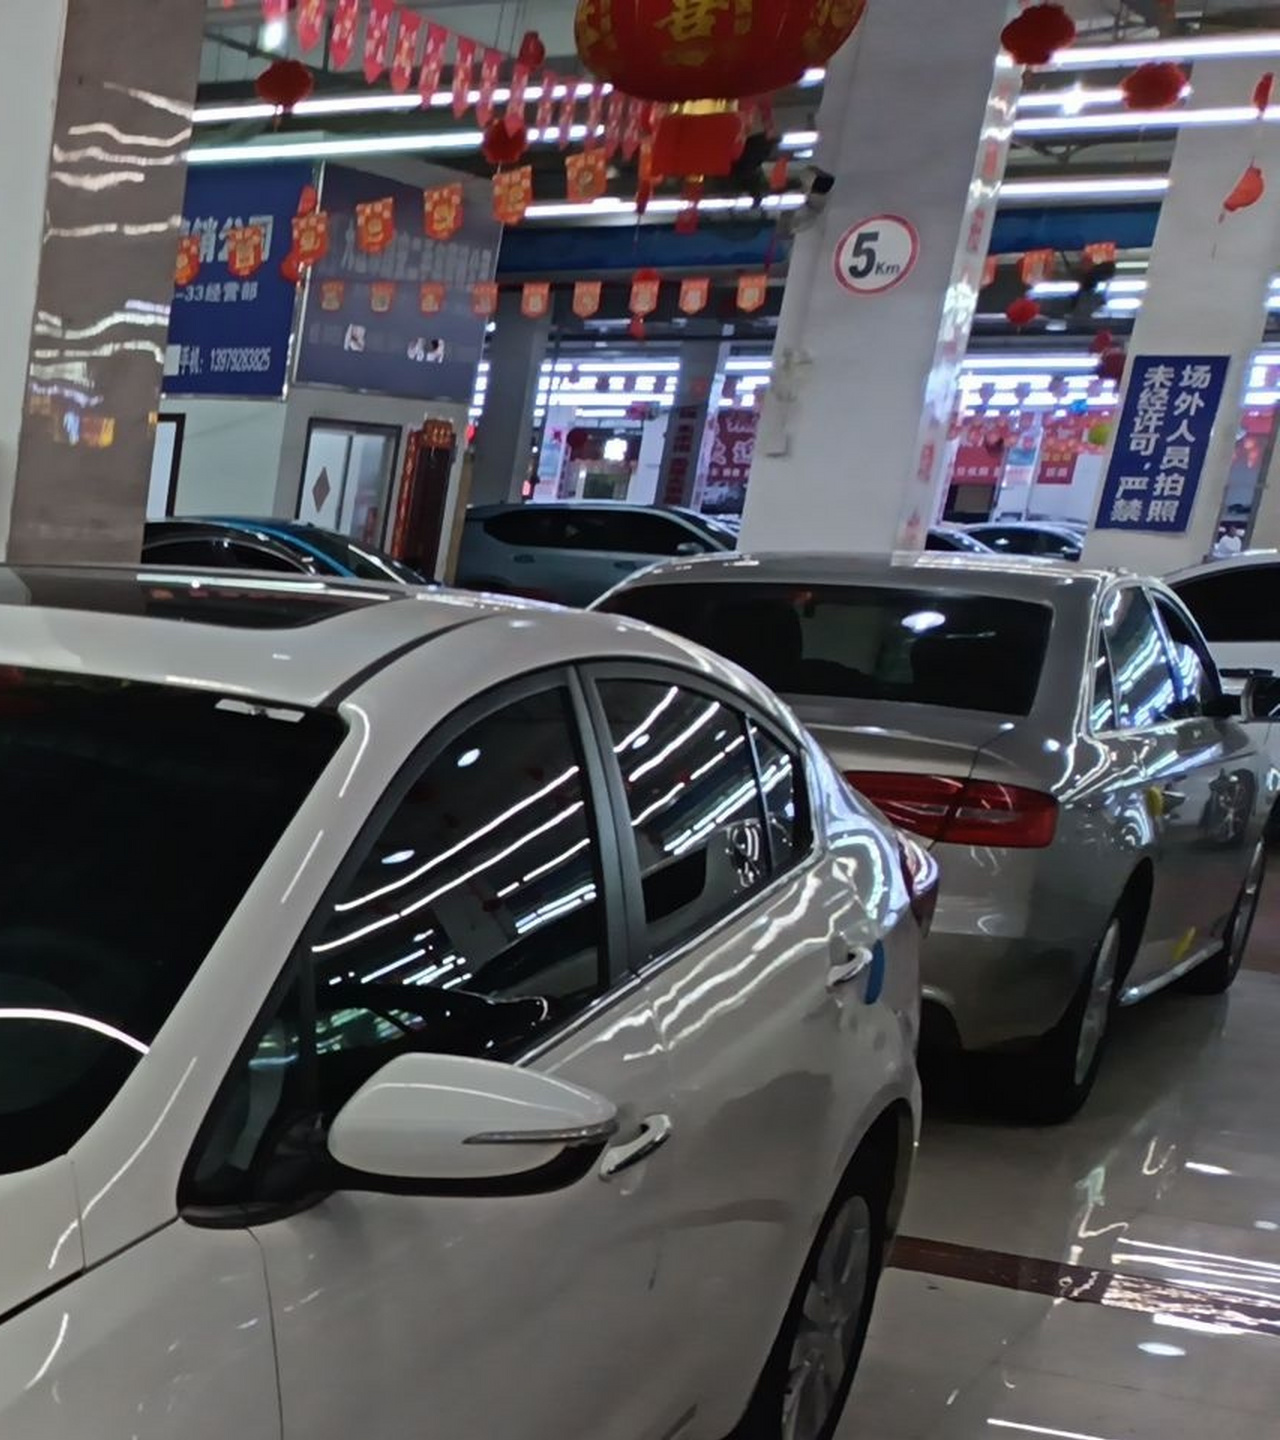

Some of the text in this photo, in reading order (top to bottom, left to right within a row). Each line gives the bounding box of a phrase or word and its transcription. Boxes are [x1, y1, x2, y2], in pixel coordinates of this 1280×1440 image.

[1146, 364, 1213, 523] 场外人员拍照
